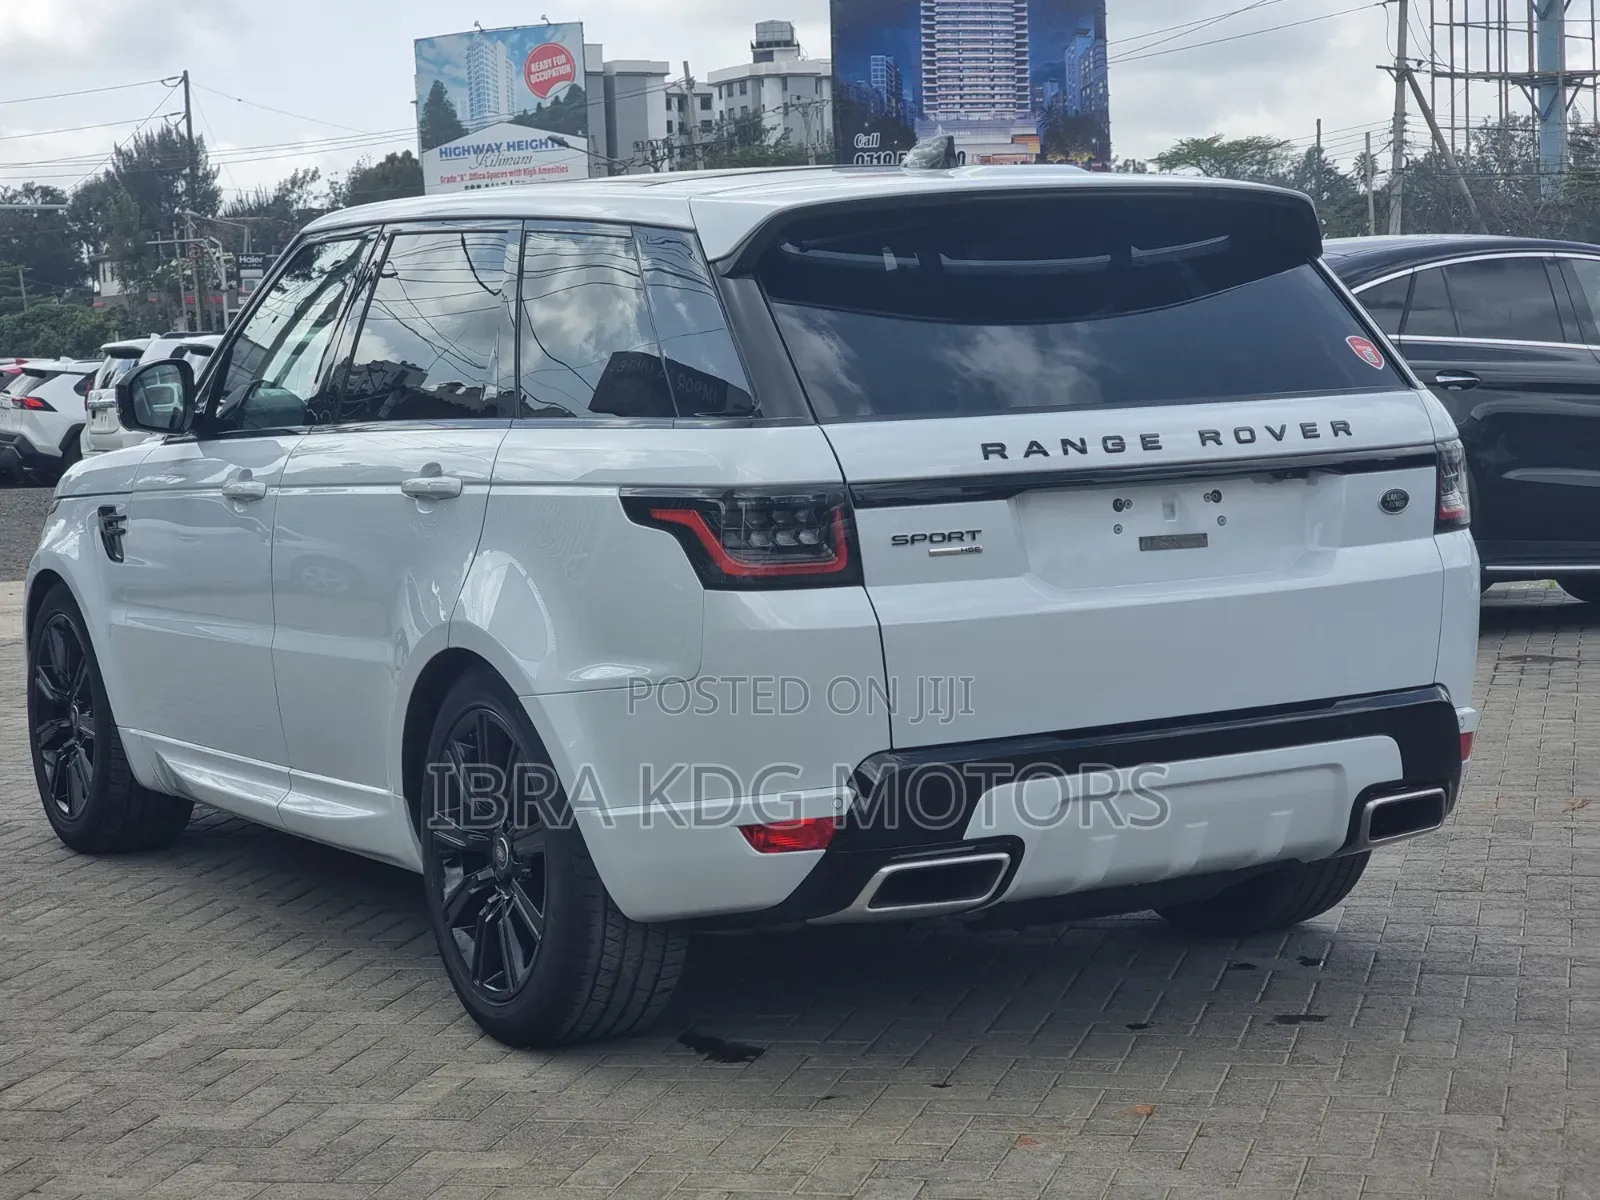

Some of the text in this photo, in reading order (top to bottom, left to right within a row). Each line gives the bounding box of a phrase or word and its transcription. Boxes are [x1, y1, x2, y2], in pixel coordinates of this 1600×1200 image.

[531, 54, 567, 73] READY FOR
[530, 63, 572, 84] OCCUPATION
[854, 132, 880, 149] Call
[439, 142, 503, 159] HIGHWAY
[440, 175, 457, 184] Grade
[486, 170, 508, 181] Spaces
[508, 168, 523, 178] with
[523, 166, 537, 178] High
[538, 164, 569, 175] Amenities
[239, 255, 263, 264] Haier
[980, 419, 1353, 462] RANGE ROVER
[891, 529, 983, 547] SPORT
[960, 546, 982, 554] HSE
